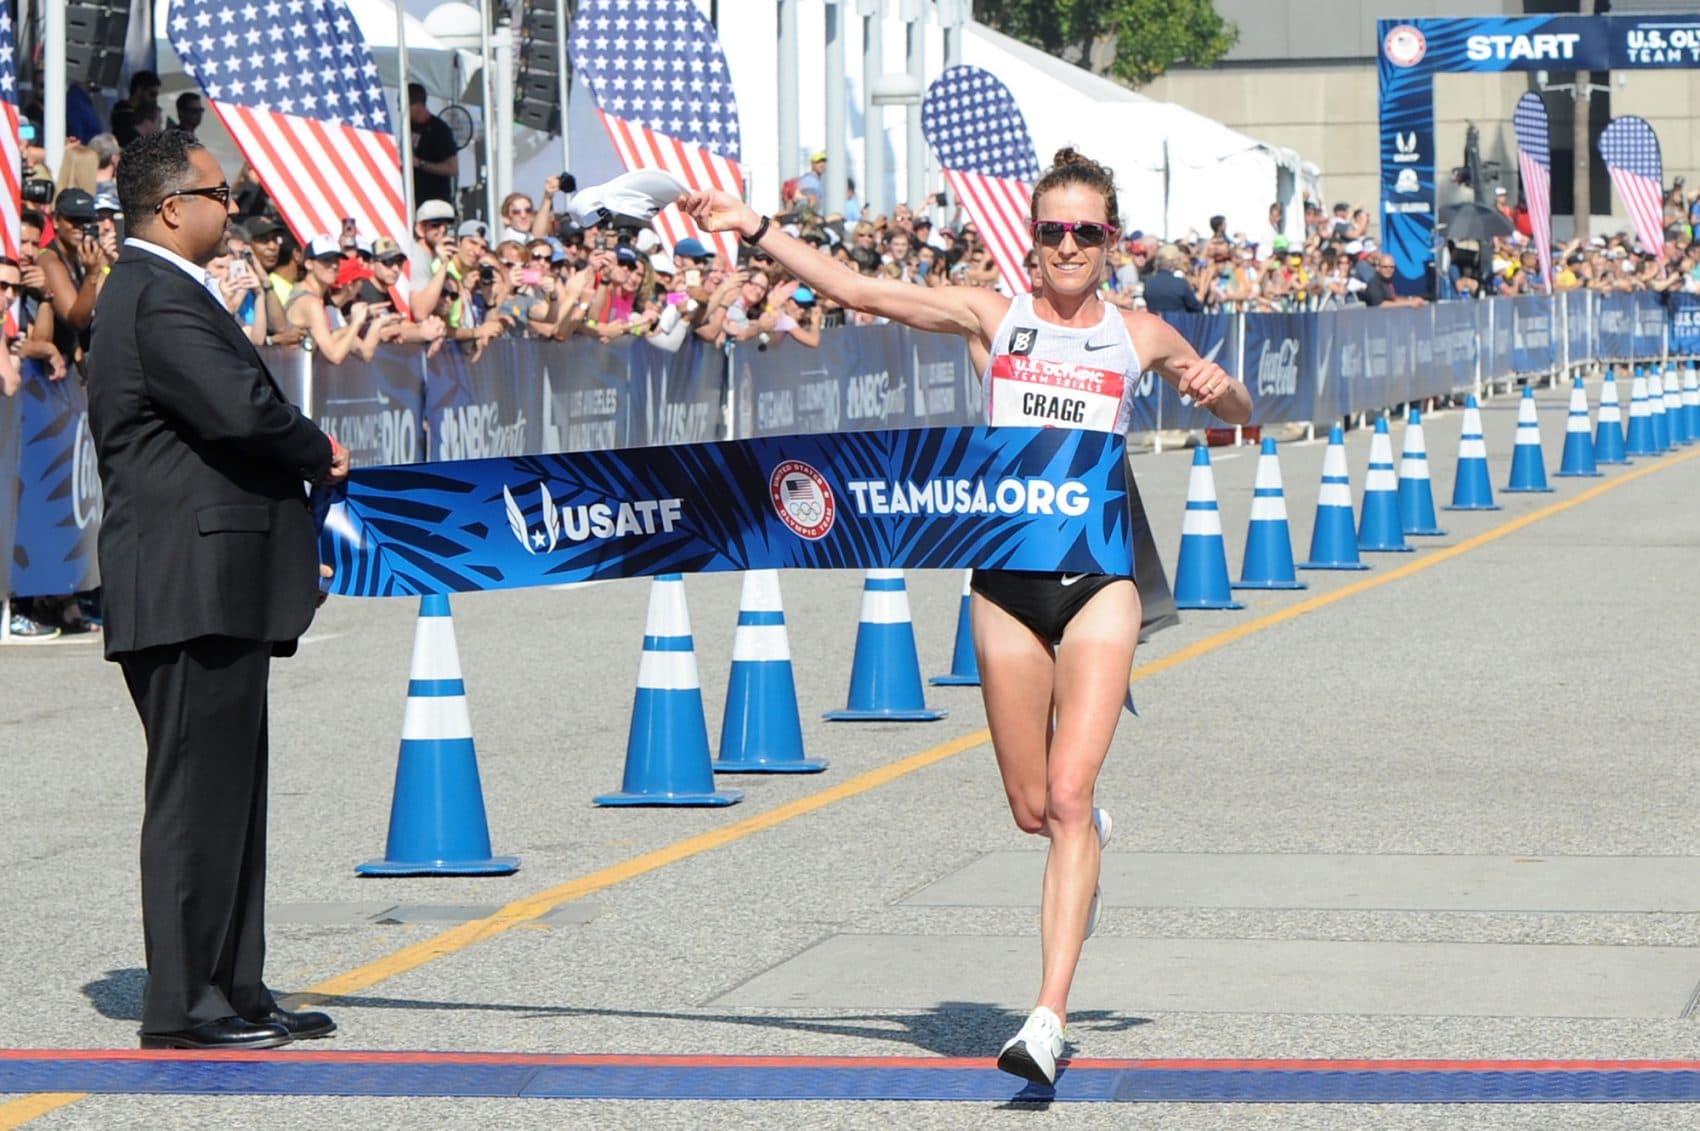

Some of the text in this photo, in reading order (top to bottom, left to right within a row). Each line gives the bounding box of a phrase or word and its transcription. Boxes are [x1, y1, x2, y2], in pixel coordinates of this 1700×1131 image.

[1466, 34, 1580, 60] START
[1627, 30, 1700, 49] U.S. OL
[1627, 49, 1682, 63] TEAM
[1014, 372, 1102, 392] TEAM TRIALS
[1042, 362, 1105, 384] OLYMPIC
[1022, 392, 1087, 423] CRAGG
[458, 405, 490, 459] NBC
[848, 479, 1090, 516] TEAMUSA.ORG
[563, 498, 684, 541] USATF
[780, 509, 818, 536] OLYMPIC
